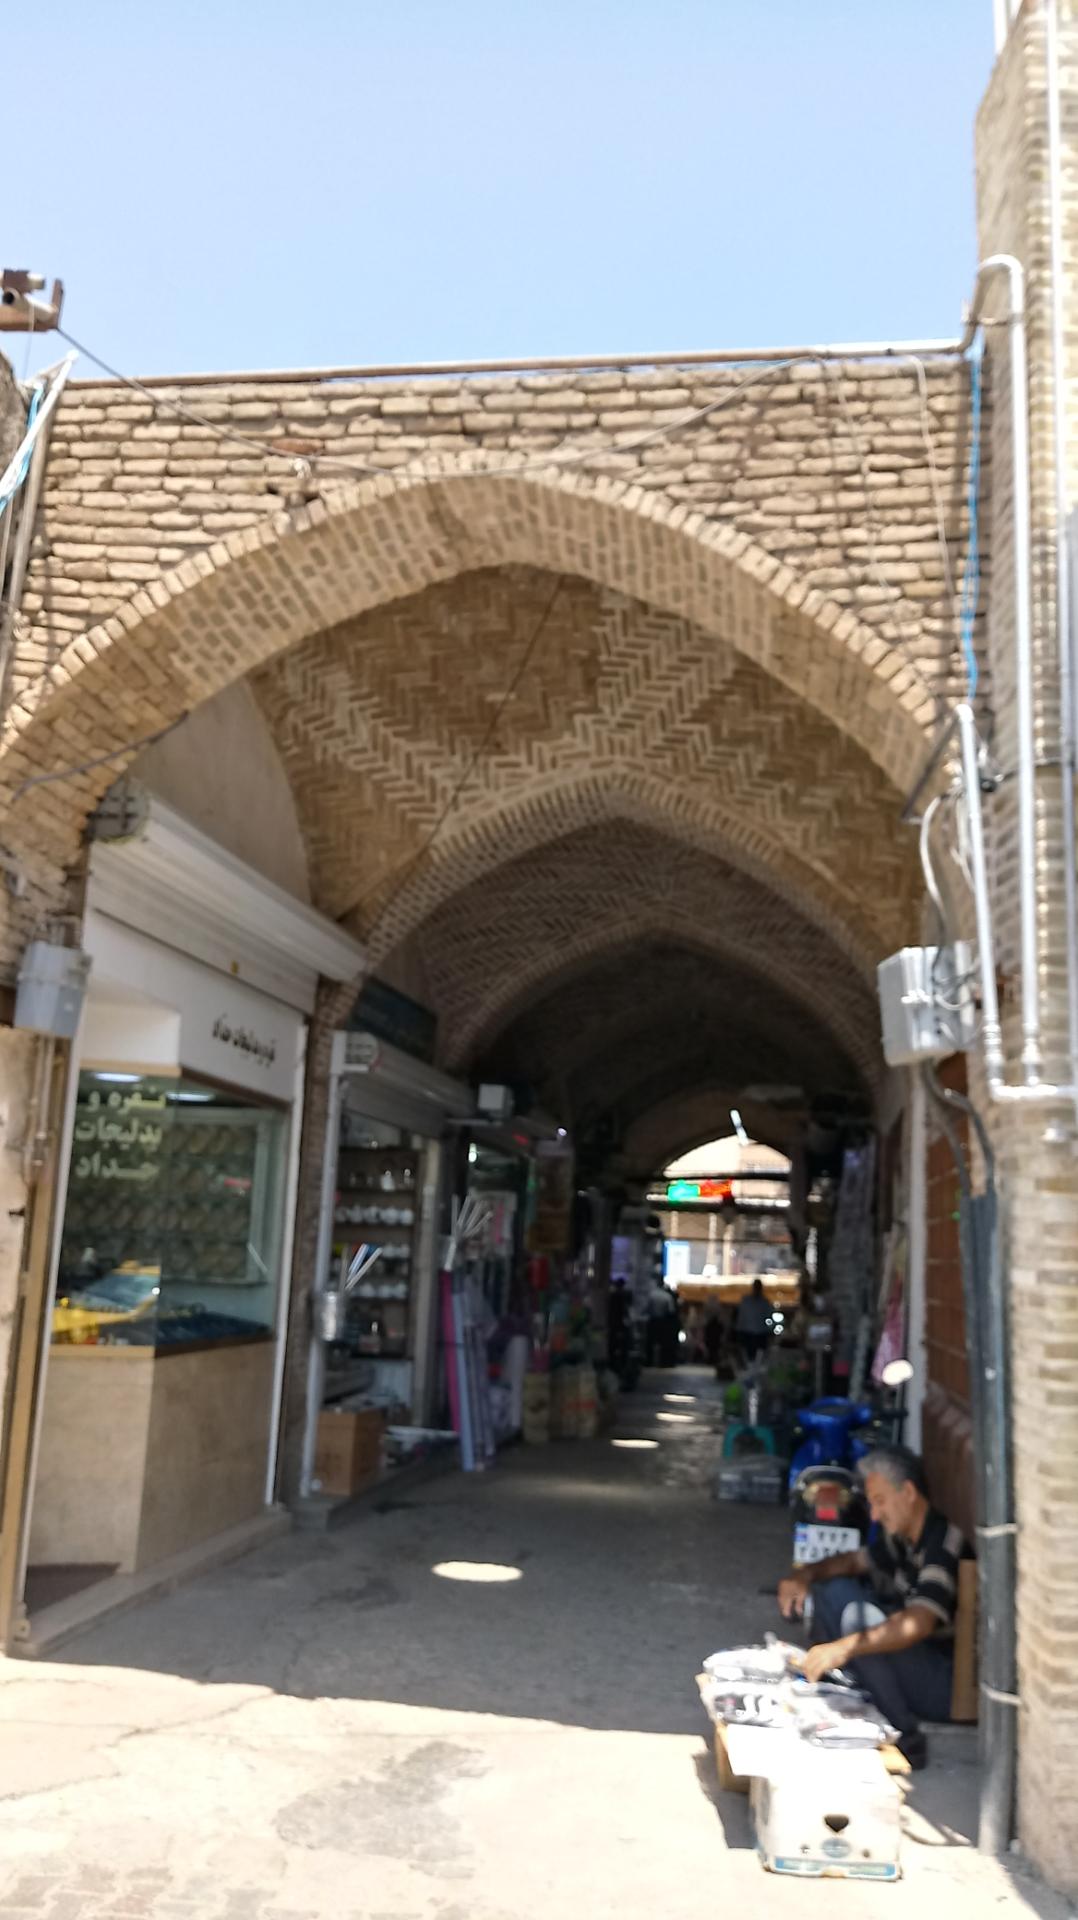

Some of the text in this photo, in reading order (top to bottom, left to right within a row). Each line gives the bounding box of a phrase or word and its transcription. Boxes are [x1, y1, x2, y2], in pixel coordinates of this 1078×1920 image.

[85, 1084, 166, 1115] نقره و
[74, 1150, 160, 1182] حداد
